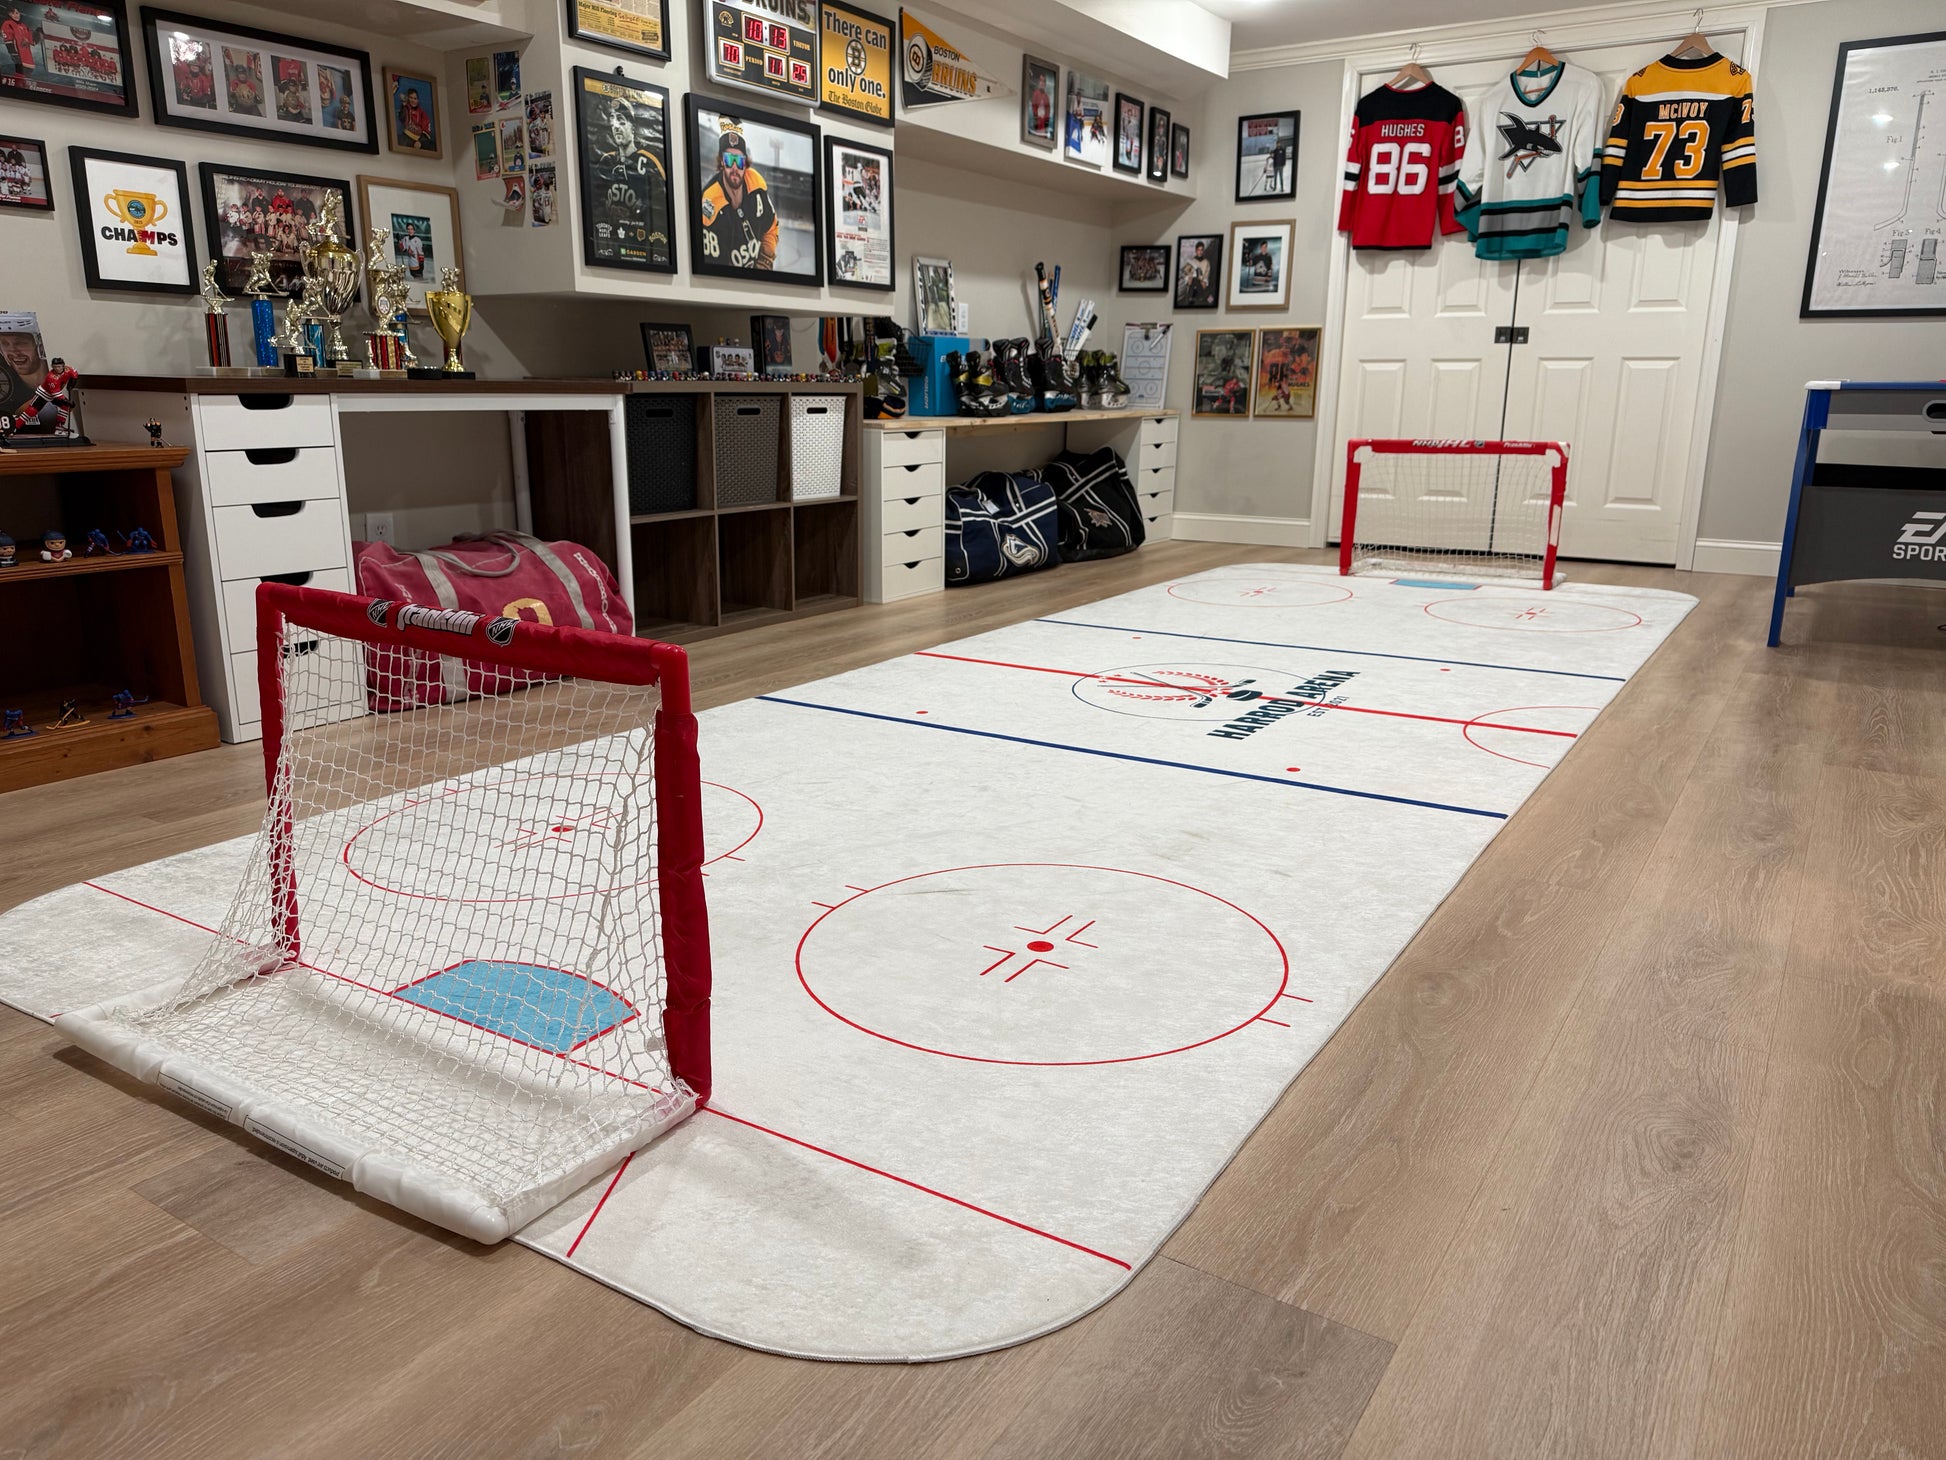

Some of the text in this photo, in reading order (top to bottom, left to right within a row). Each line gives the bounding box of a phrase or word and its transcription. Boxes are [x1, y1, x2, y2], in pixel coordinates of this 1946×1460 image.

[744, 0, 811, 25] UINS
[823, 10, 887, 50] There can
[723, 43, 739, 64] 70
[933, 45, 961, 62] BOSTON
[792, 64, 807, 83] 25
[828, 67, 886, 99] only one.
[932, 60, 977, 97] BRUINS
[828, 90, 883, 116] The Boston Globe
[1381, 124, 1425, 137] HUGHES
[1641, 120, 1710, 180] 73
[637, 156, 648, 176] C
[1367, 142, 1432, 195] 86
[756, 194, 764, 218] A
[101, 226, 178, 247] CHAMPS
[397, 603, 483, 635] Franklin
[1206, 670, 1361, 741] HARROD ARENA
